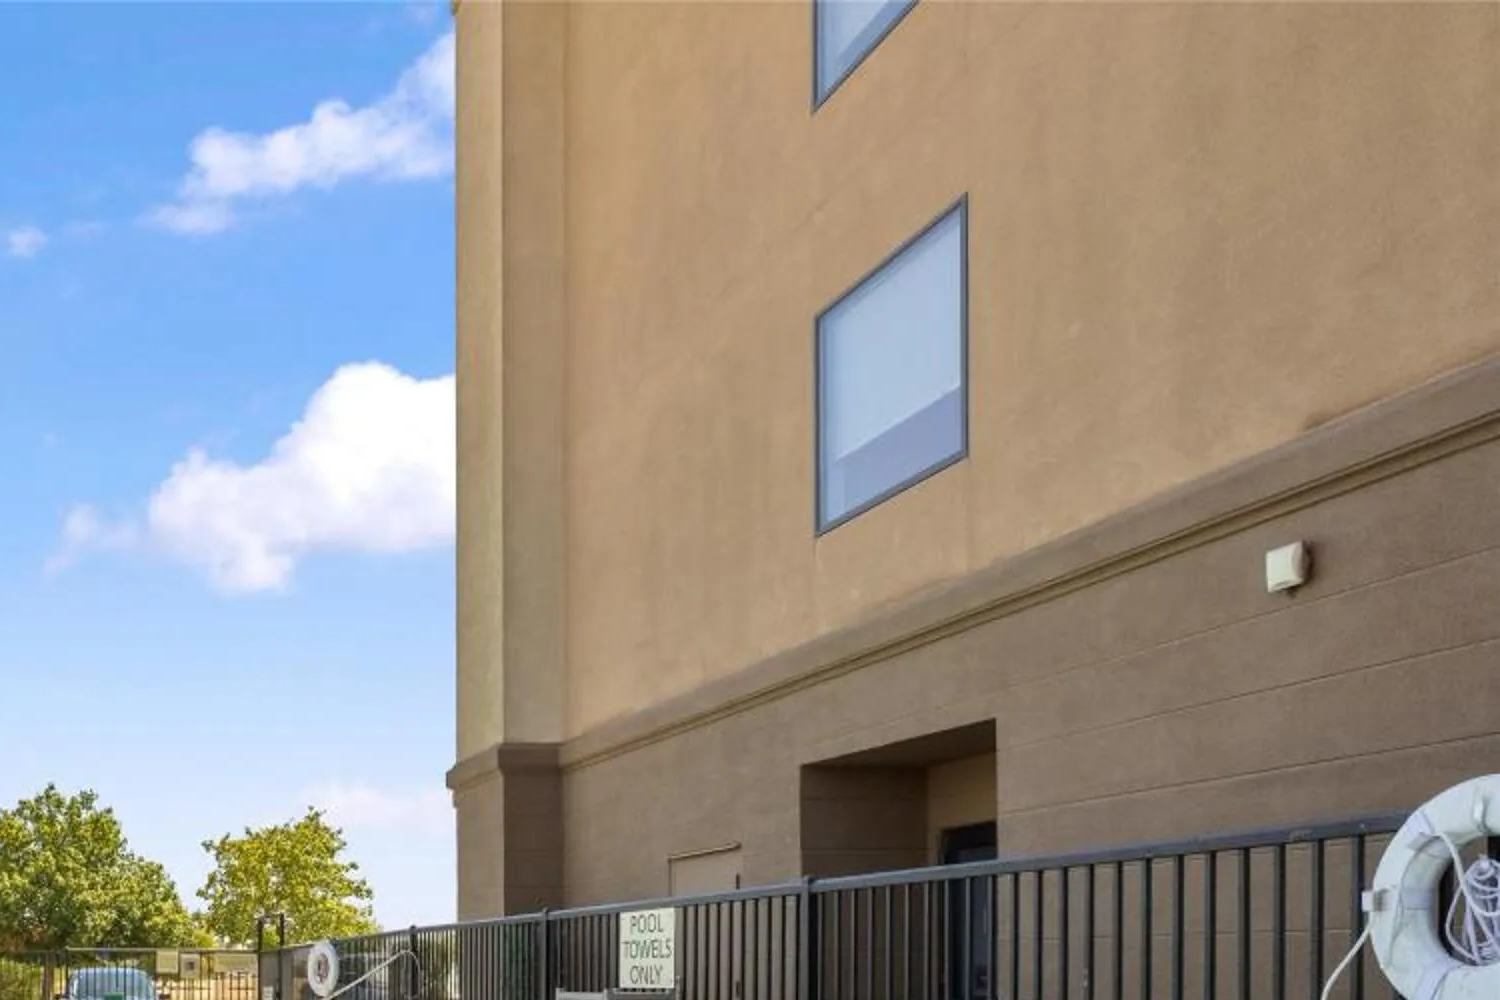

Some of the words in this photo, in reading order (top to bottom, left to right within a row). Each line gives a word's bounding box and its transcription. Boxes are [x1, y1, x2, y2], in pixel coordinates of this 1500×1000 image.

[630, 913, 664, 934] POOL
[621, 938, 673, 960] TOWELS
[629, 964, 663, 985] ONLY
